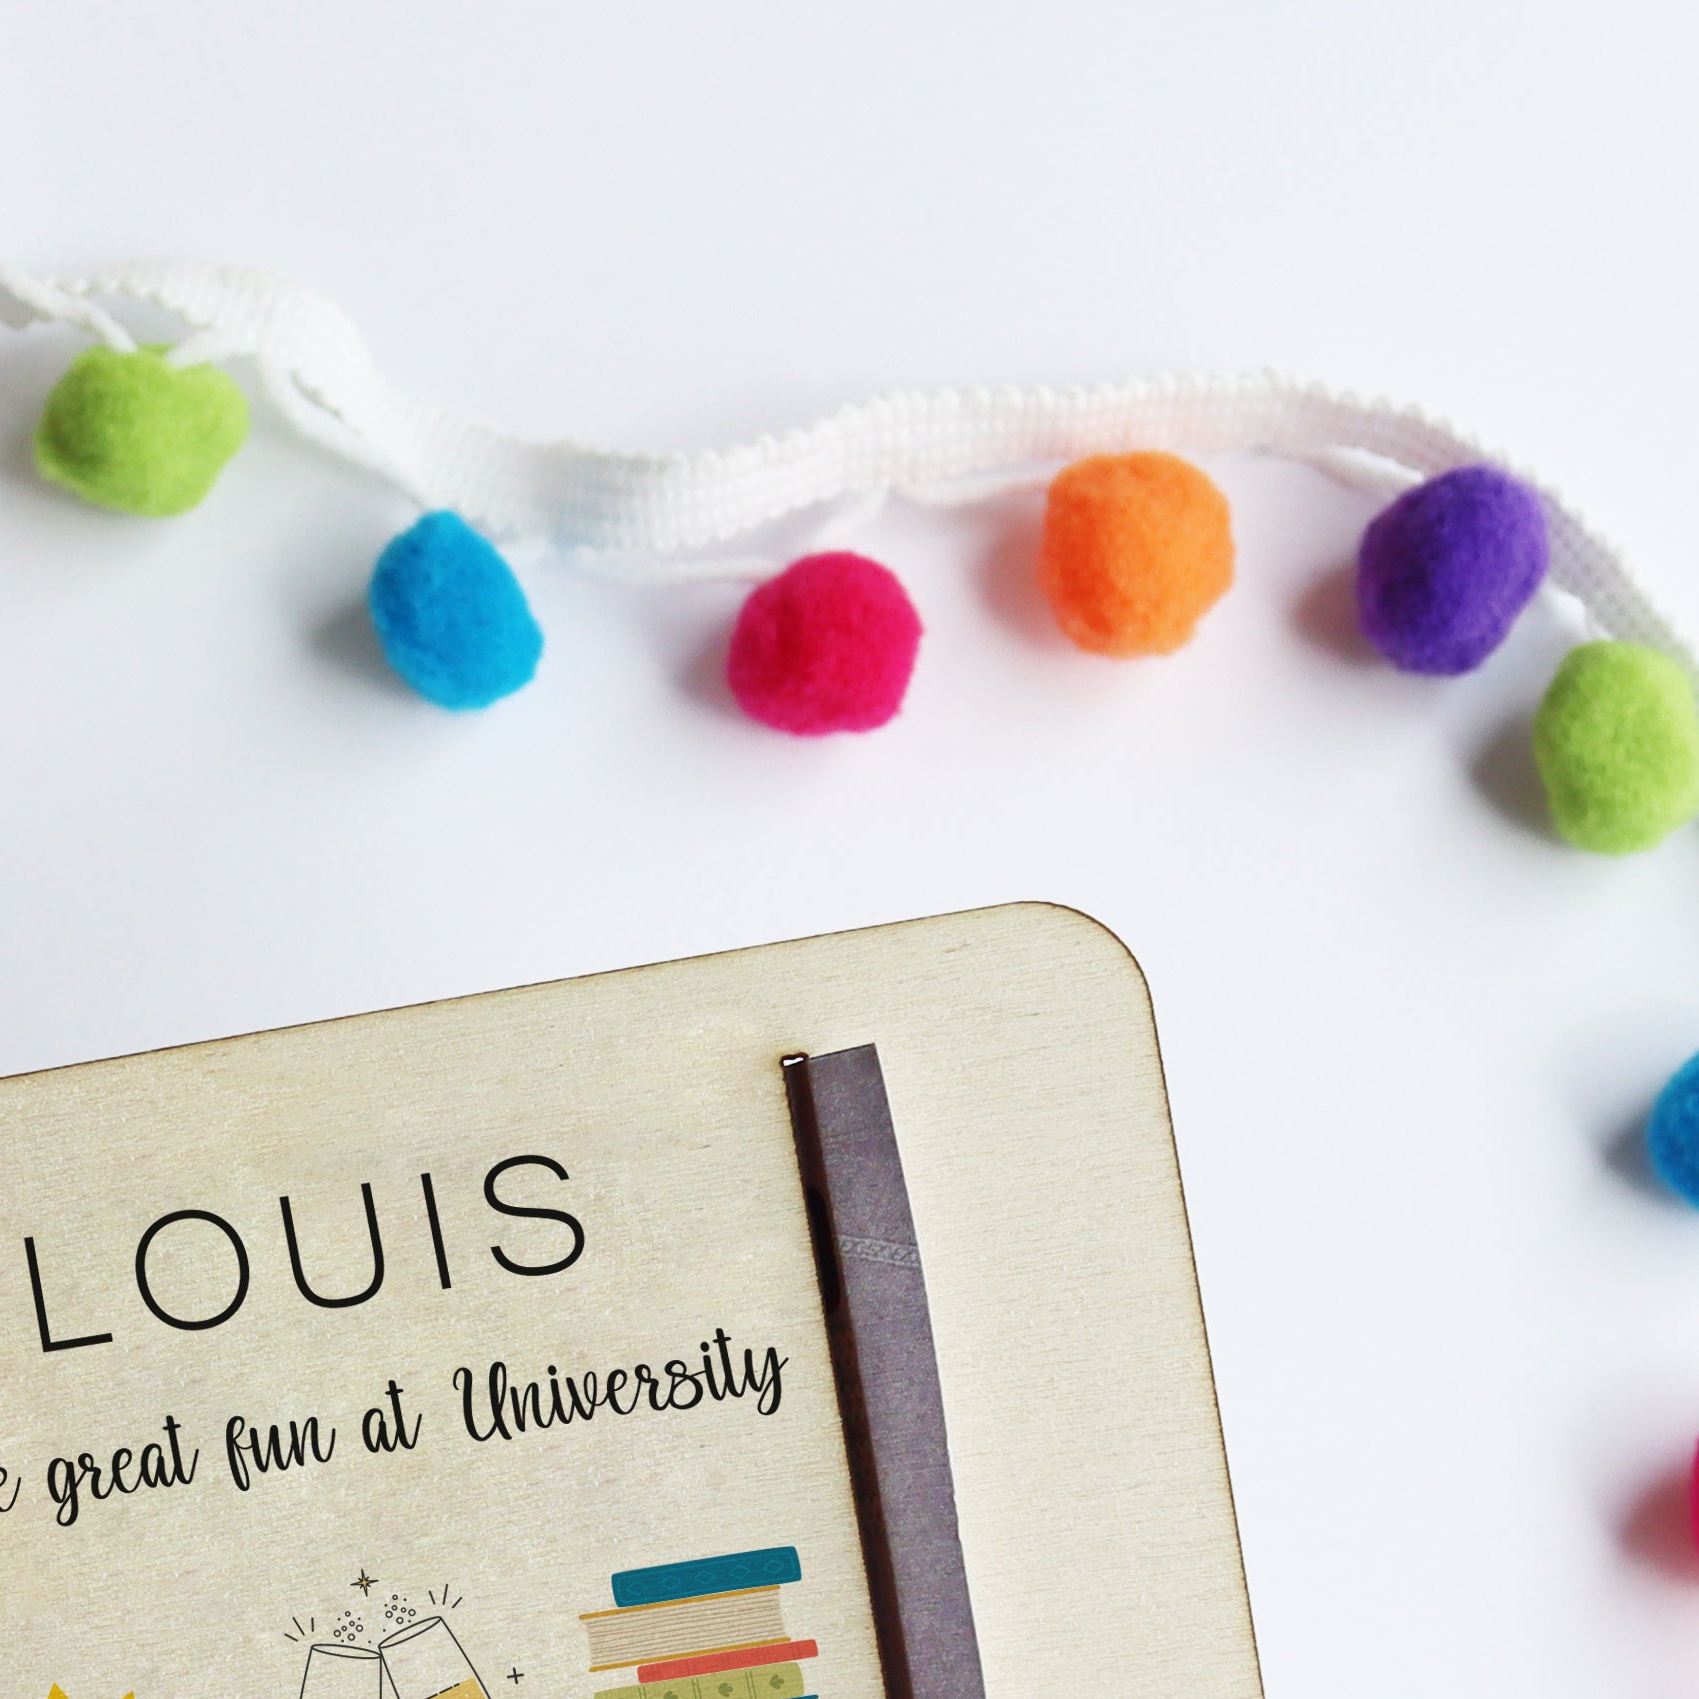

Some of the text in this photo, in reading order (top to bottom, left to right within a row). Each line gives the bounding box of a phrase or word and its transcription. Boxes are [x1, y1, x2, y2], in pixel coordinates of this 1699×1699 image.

[23, 1154, 586, 1353] LOUIS
[47, 1414, 199, 1527] great
[226, 1415, 336, 1492] fun
[362, 1379, 422, 1454] at
[452, 1327, 789, 1442] University
